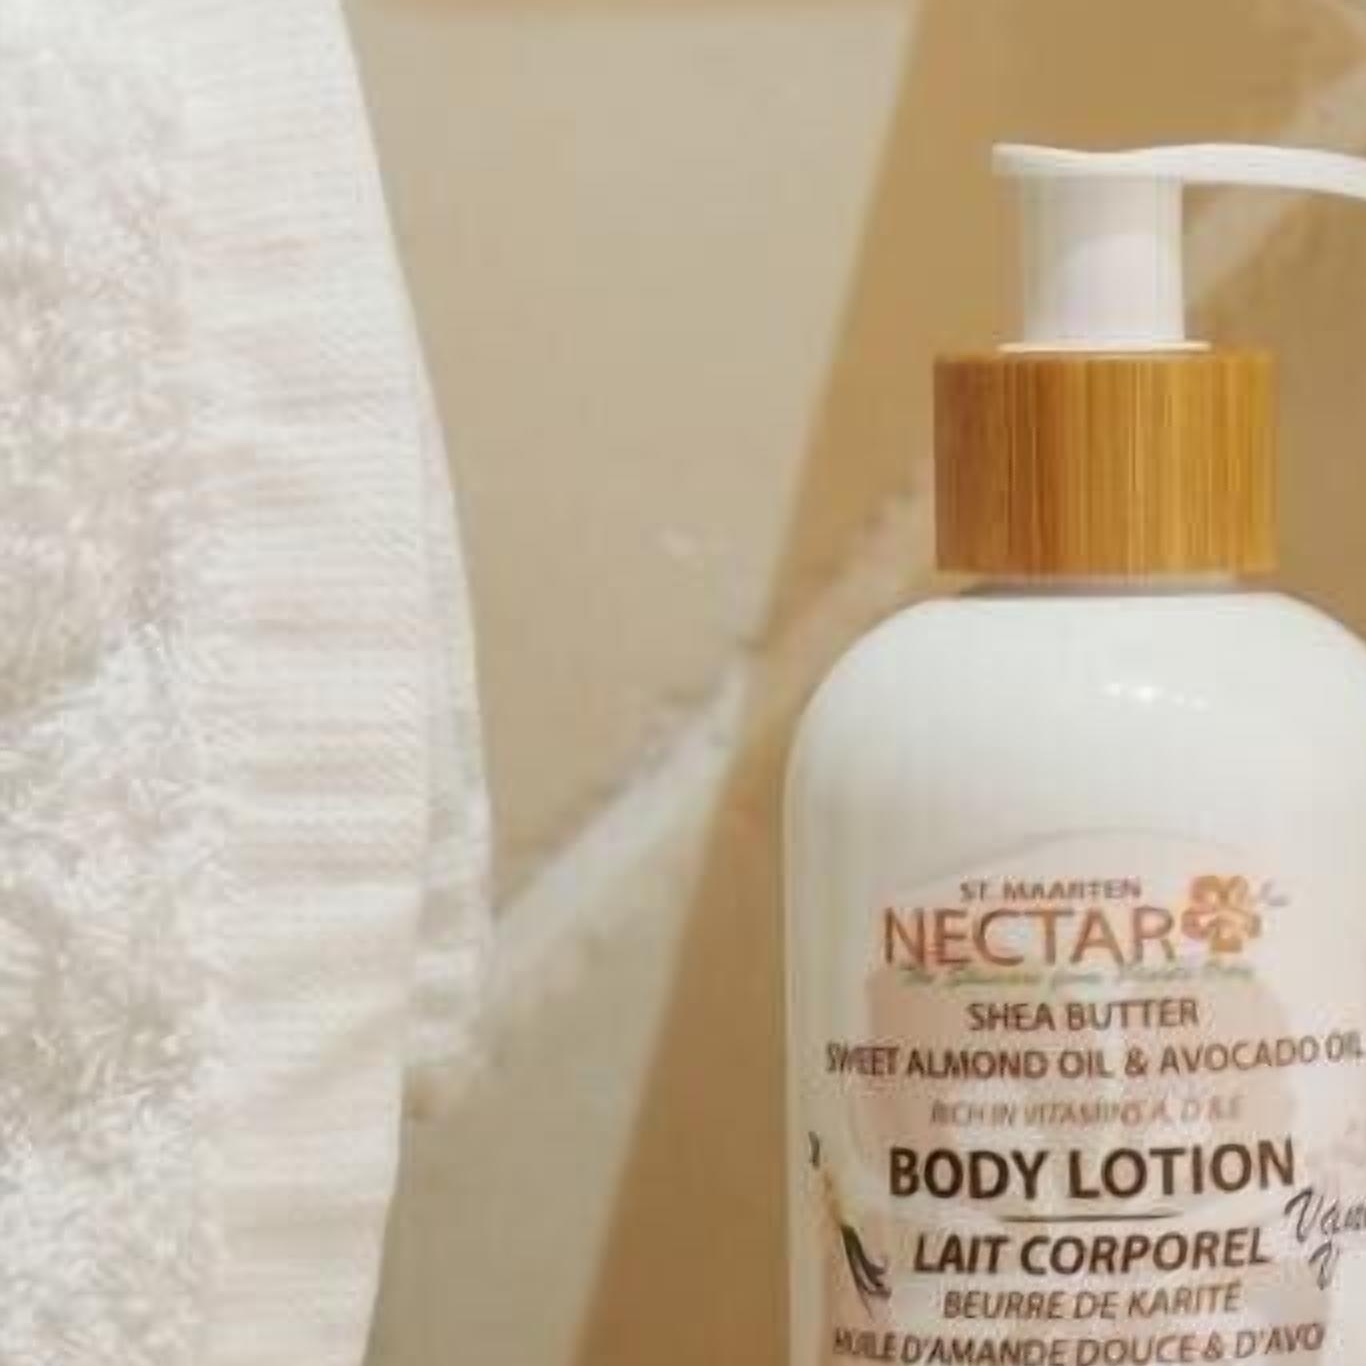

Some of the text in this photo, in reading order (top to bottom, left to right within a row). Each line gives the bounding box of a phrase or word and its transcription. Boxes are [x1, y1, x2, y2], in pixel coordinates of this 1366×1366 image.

[1003, 877, 1142, 903] MAARTEN
[884, 904, 1176, 968] NECTAR
[968, 999, 1199, 1032] SHEA BUTTER
[826, 1042, 898, 1076] SWEET
[906, 1049, 1047, 1079] ALMOND
[1057, 1048, 1113, 1079] OIL
[1124, 1048, 1148, 1077] &
[1160, 1036, 1317, 1075] AVOCADO
[890, 1138, 1295, 1201] BODY LOTION
[914, 1234, 1002, 1275] LAIT
[1020, 1225, 1271, 1275] CORPOREL
[942, 1289, 1064, 1321] BEURRE
[1073, 1288, 1116, 1320] DE
[1076, 1332, 1197, 1366] DOUCE
[1203, 1329, 1225, 1362] &
[1234, 1321, 1327, 1360] D'AVO
